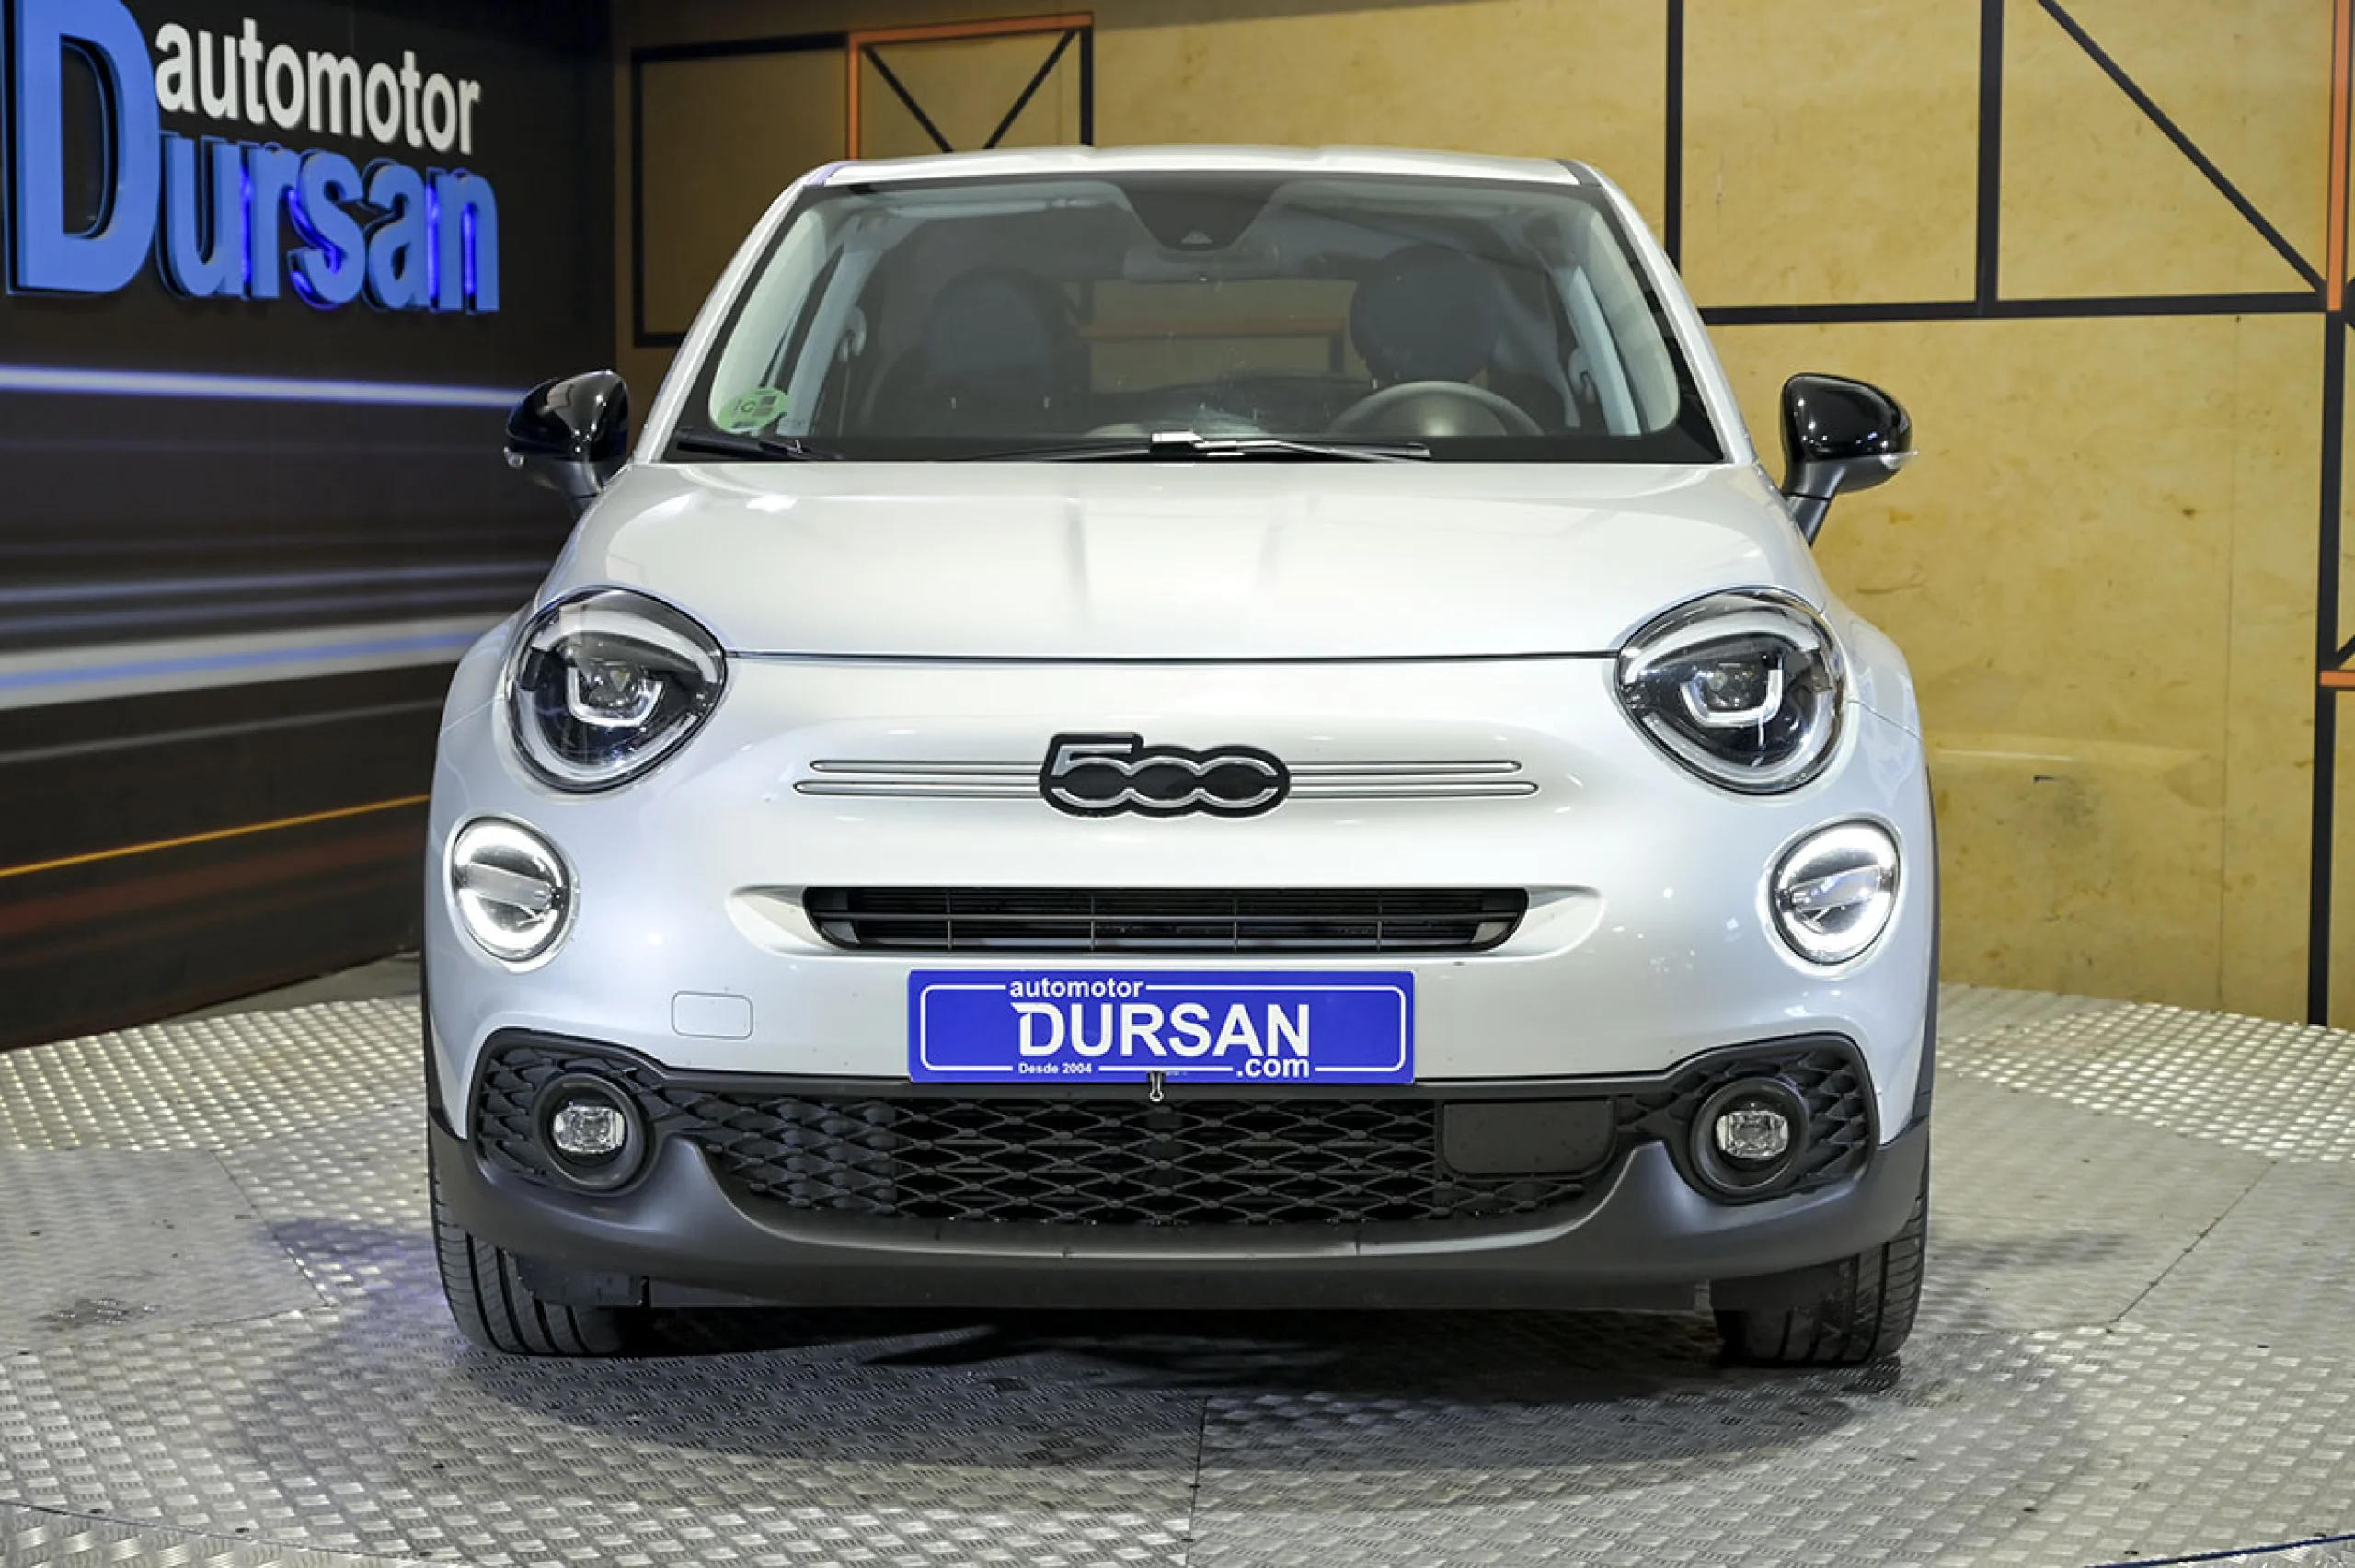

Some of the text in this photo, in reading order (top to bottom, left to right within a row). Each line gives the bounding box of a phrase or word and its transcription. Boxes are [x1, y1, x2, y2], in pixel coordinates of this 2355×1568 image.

[155, 18, 480, 155] automotor
[6, 0, 500, 312] Dursan
[1040, 732, 1290, 818] 500
[1011, 978, 1143, 998] automotor
[1011, 1002, 1310, 1057] DURSAN
[1018, 1063, 1092, 1074] Desde 2004
[1235, 1058, 1310, 1078] .com
